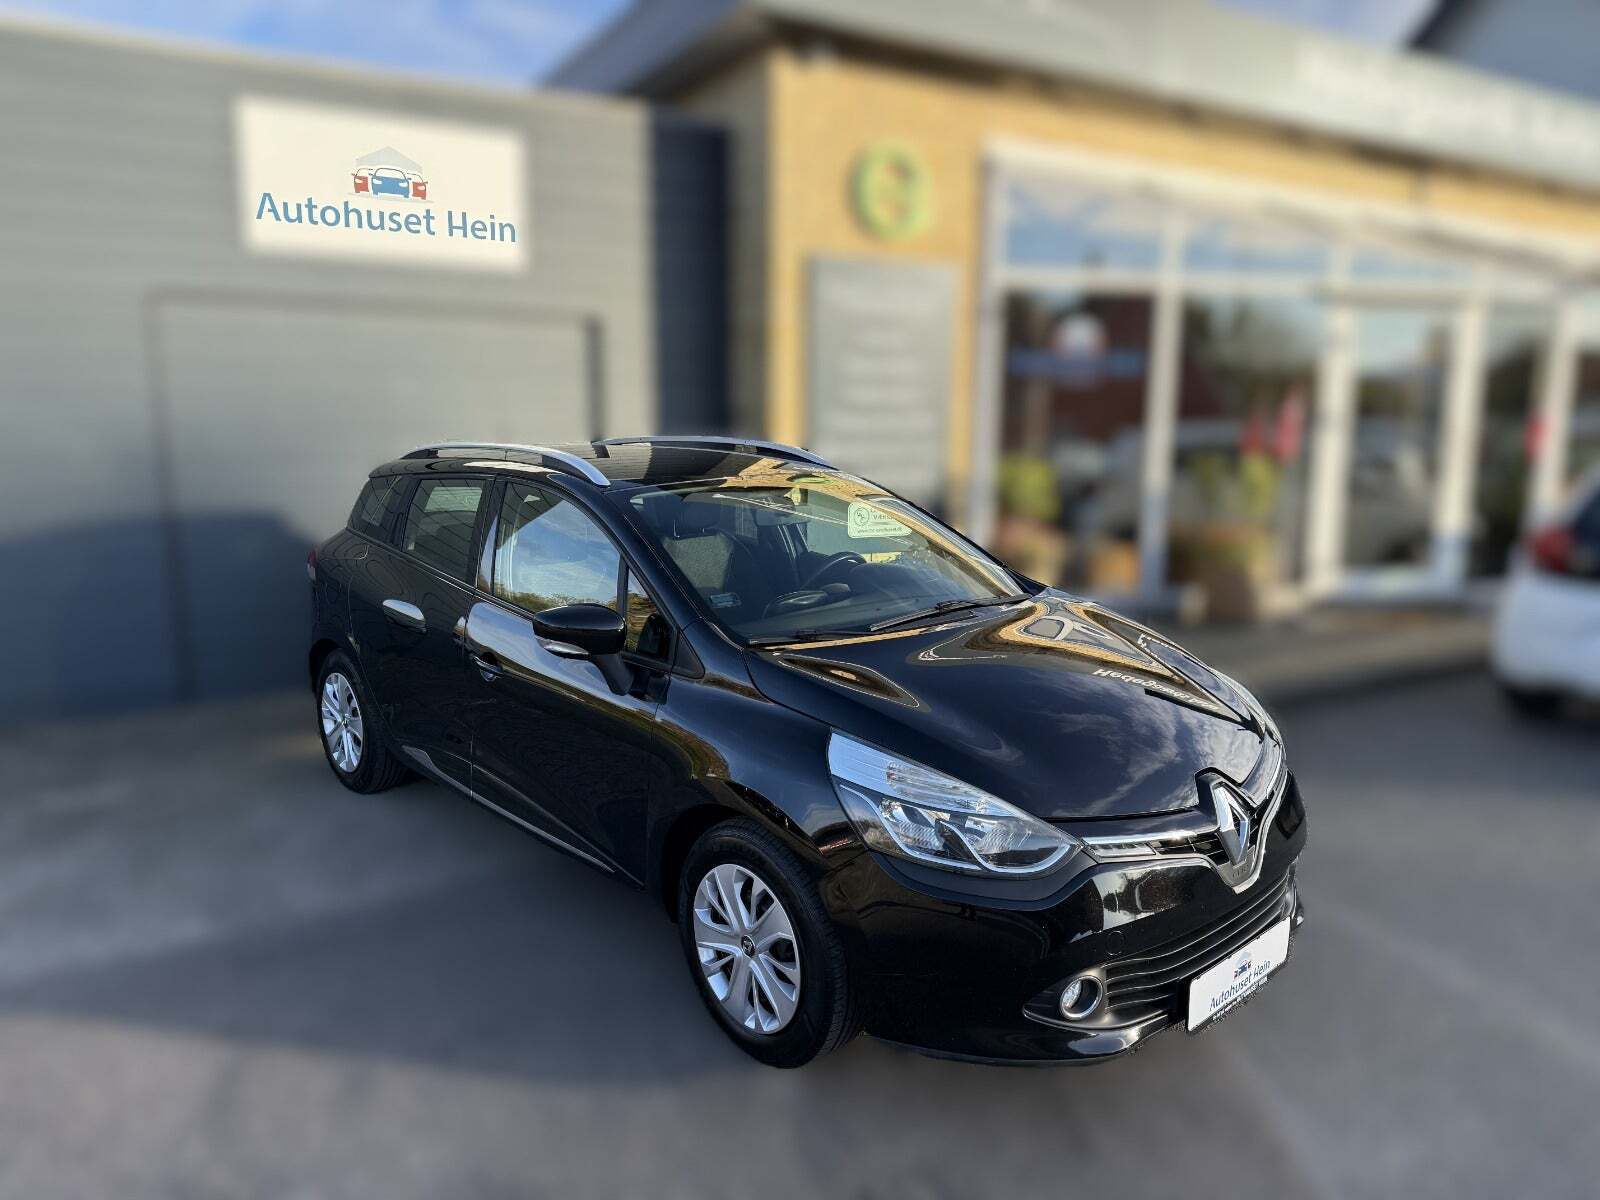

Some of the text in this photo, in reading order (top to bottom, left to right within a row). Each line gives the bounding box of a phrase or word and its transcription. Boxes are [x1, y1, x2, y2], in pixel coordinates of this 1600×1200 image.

[255, 192, 517, 243] Autohuset Hein
[1209, 973, 1253, 1012] Autohuset
[1253, 959, 1271, 979] Hein
